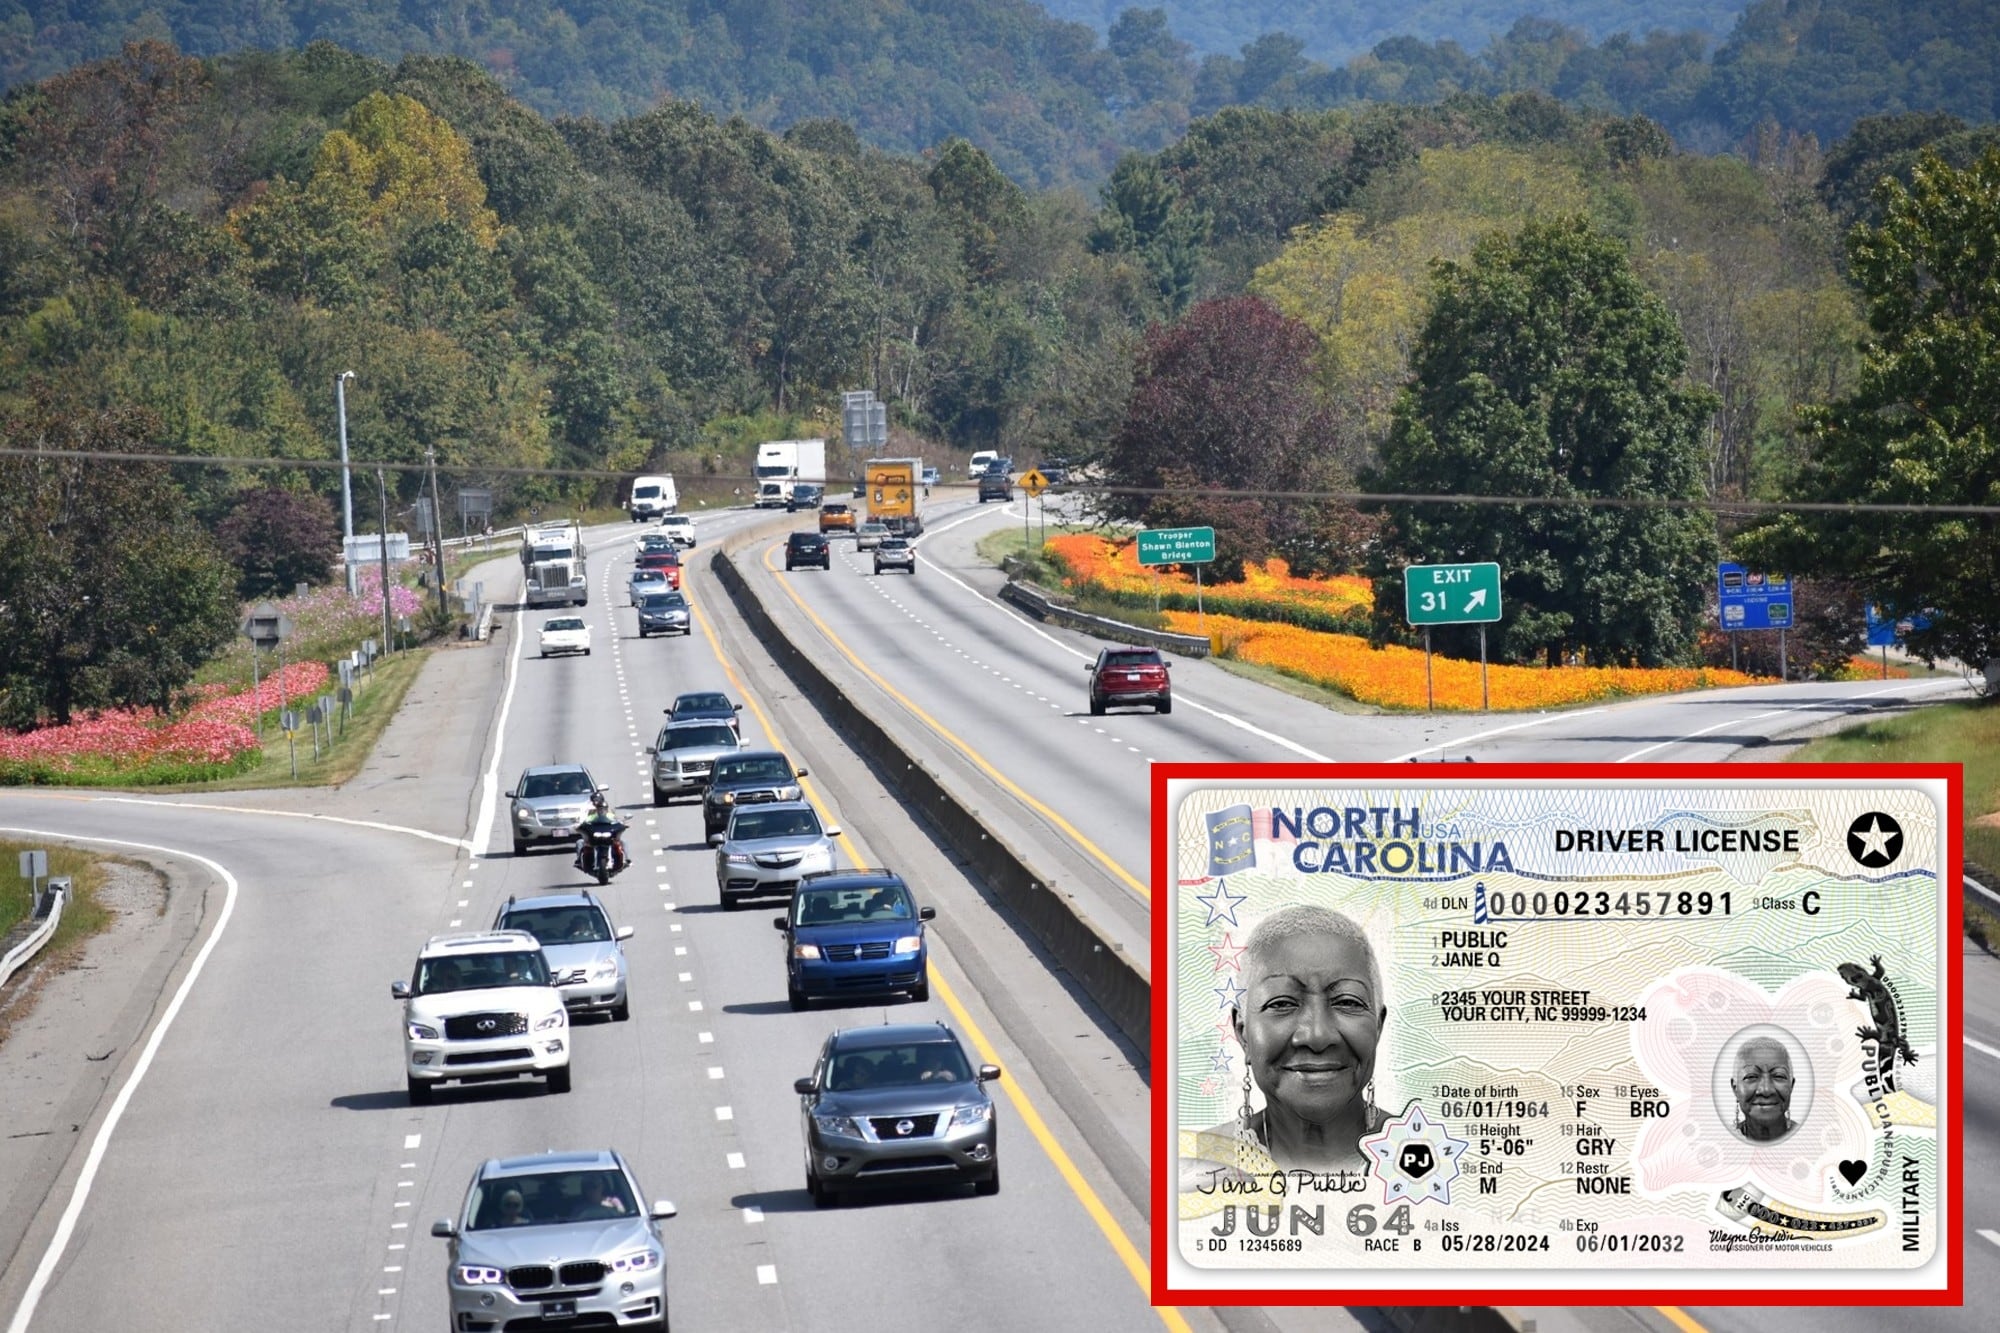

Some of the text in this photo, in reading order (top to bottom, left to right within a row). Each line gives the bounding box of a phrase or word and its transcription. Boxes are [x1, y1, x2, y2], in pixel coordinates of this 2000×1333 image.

[1158, 532, 1192, 540] Trooper
[1142, 541, 1211, 551] Shawn Blanton
[1161, 551, 1192, 560] Bridge
[1433, 569, 1472, 584] EXIT
[1421, 591, 1447, 611] 31
